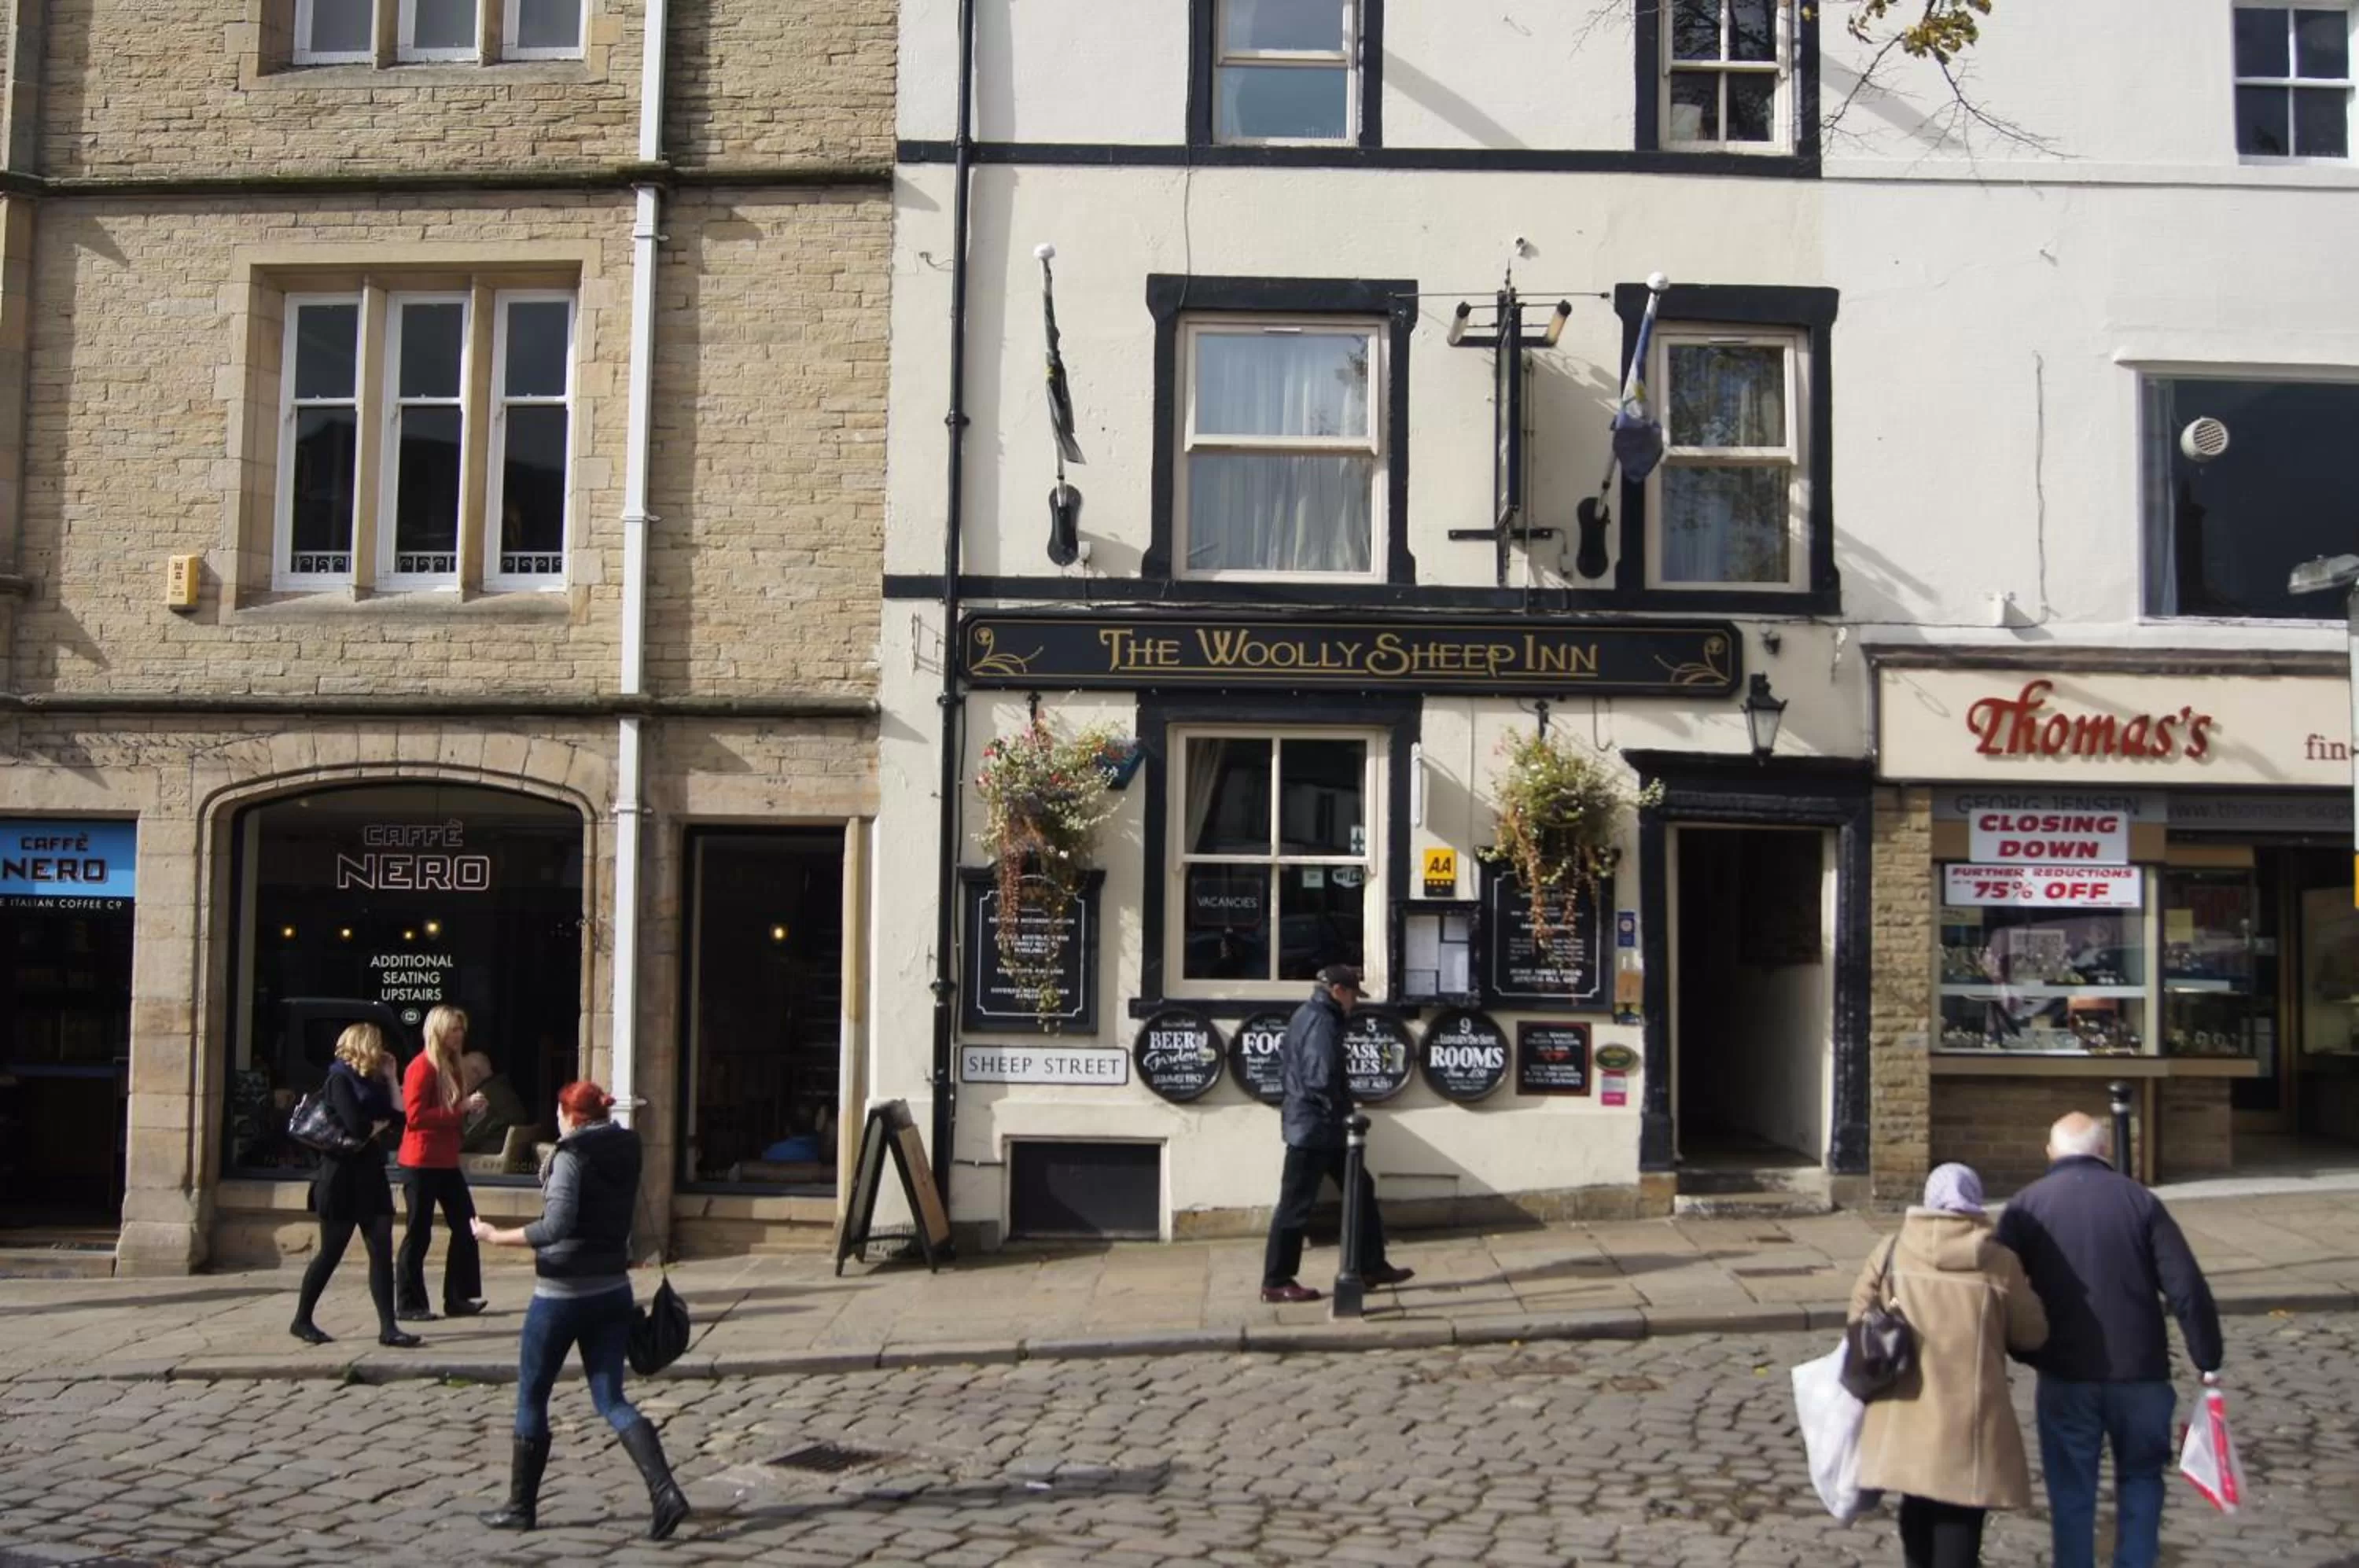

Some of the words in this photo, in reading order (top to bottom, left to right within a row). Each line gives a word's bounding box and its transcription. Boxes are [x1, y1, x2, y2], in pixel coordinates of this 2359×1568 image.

[1100, 629, 1180, 672] THE
[1196, 629, 1362, 668] WOOLLY
[1366, 633, 1515, 677] SHEEP
[1524, 635, 1599, 671] INN
[1967, 679, 2212, 760] Thomas's
[2305, 733, 2349, 760] fin
[1978, 815, 2118, 833] CLOSING
[1998, 841, 2100, 859] DOWN
[2, 856, 109, 884] NERO
[337, 853, 490, 891] NERO
[1428, 856, 1452, 873] AA
[1952, 867, 2025, 878] FURTHER
[2033, 868, 2133, 878] REDUCTIONS
[1974, 882, 2033, 899] 75%
[2044, 882, 2109, 899] OFF
[10, 898, 54, 908] ITALIAN
[59, 899, 101, 909] COFFEE
[1197, 896, 1257, 908] VACANCIES
[370, 955, 453, 967] ADDITIONAL
[382, 971, 440, 984] SEATING
[381, 988, 443, 1001] UPSTAIRS
[1459, 1018, 1472, 1034] 9
[1149, 1031, 1196, 1050] BEER
[1241, 1032, 1285, 1055] FO
[968, 1056, 1032, 1073] SHEEP
[1044, 1058, 1120, 1075] STREET
[1430, 1045, 1505, 1069] ROOMS
